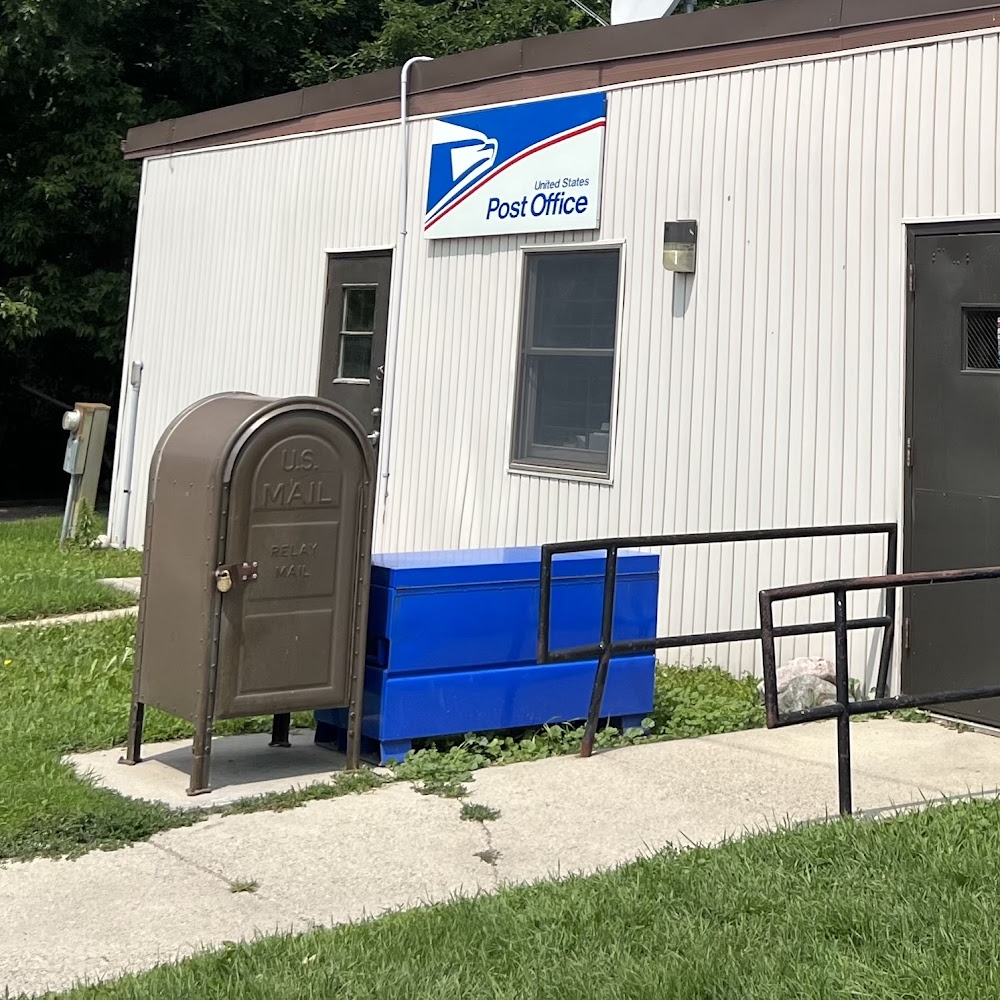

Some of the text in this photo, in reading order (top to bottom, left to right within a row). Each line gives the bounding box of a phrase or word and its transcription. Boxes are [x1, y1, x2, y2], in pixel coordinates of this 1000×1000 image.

[534, 177, 590, 191] United States
[486, 191, 588, 220] Post Office
[282, 448, 319, 470] U.S.
[262, 481, 332, 506] MAIL
[271, 543, 319, 558] RELAY
[275, 564, 311, 579] MAIL
